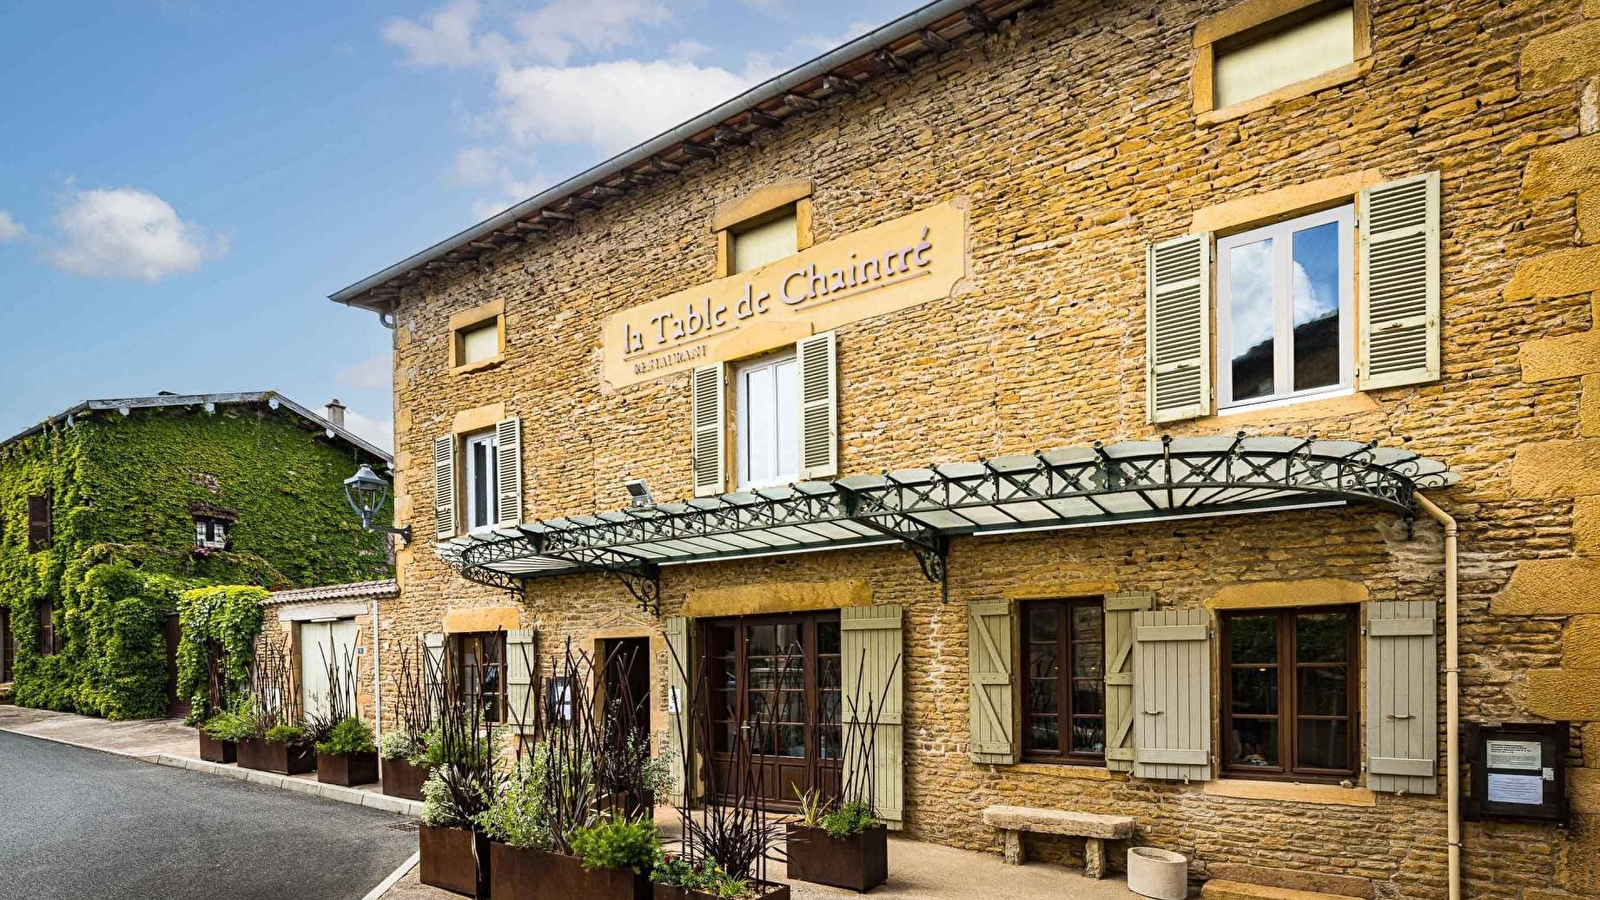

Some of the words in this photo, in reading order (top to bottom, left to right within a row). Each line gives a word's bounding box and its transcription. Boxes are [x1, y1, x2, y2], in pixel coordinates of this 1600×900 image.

[623, 321, 644, 355] la
[651, 296, 728, 345] Table
[735, 282, 771, 321] de
[779, 225, 933, 306] Chaintré
[633, 344, 707, 375] RESTAURANT
